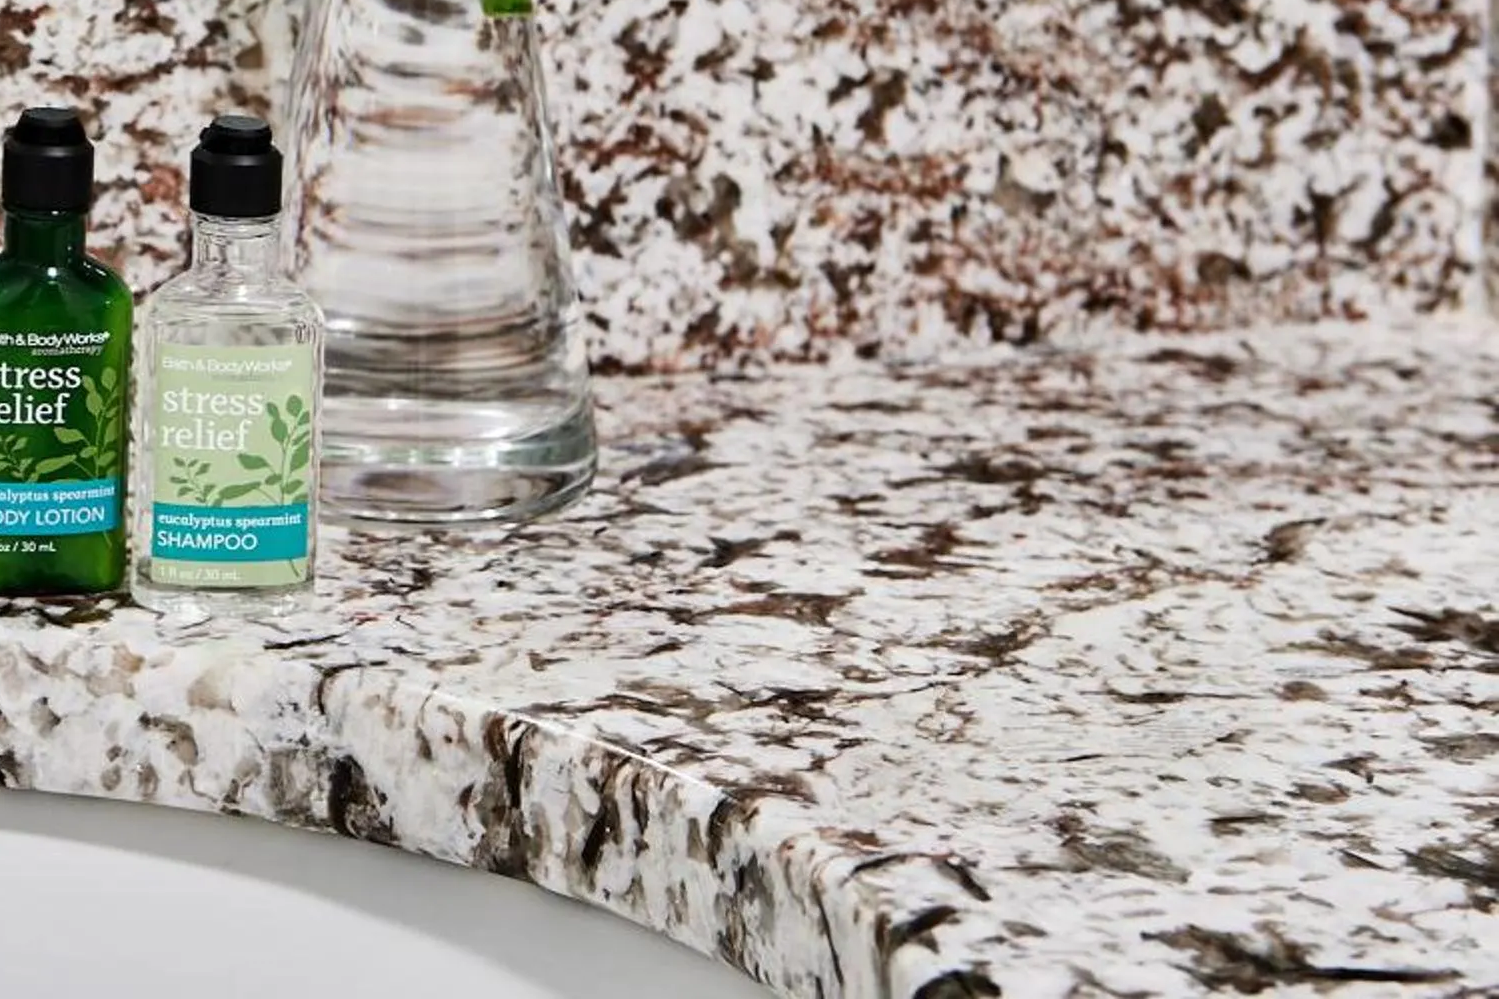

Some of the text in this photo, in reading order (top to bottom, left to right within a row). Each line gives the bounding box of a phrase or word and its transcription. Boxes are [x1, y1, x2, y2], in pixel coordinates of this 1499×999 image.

[15, 333, 26, 346] &
[162, 387, 264, 415] stress
[161, 418, 252, 450] relief
[52, 485, 116, 504] spearmint
[35, 506, 105, 526] LOTION
[157, 513, 302, 531] eucalyptus spearmint
[21, 541, 36, 552] 30
[38, 542, 57, 552] mL
[156, 530, 258, 550] SHAMPOO
